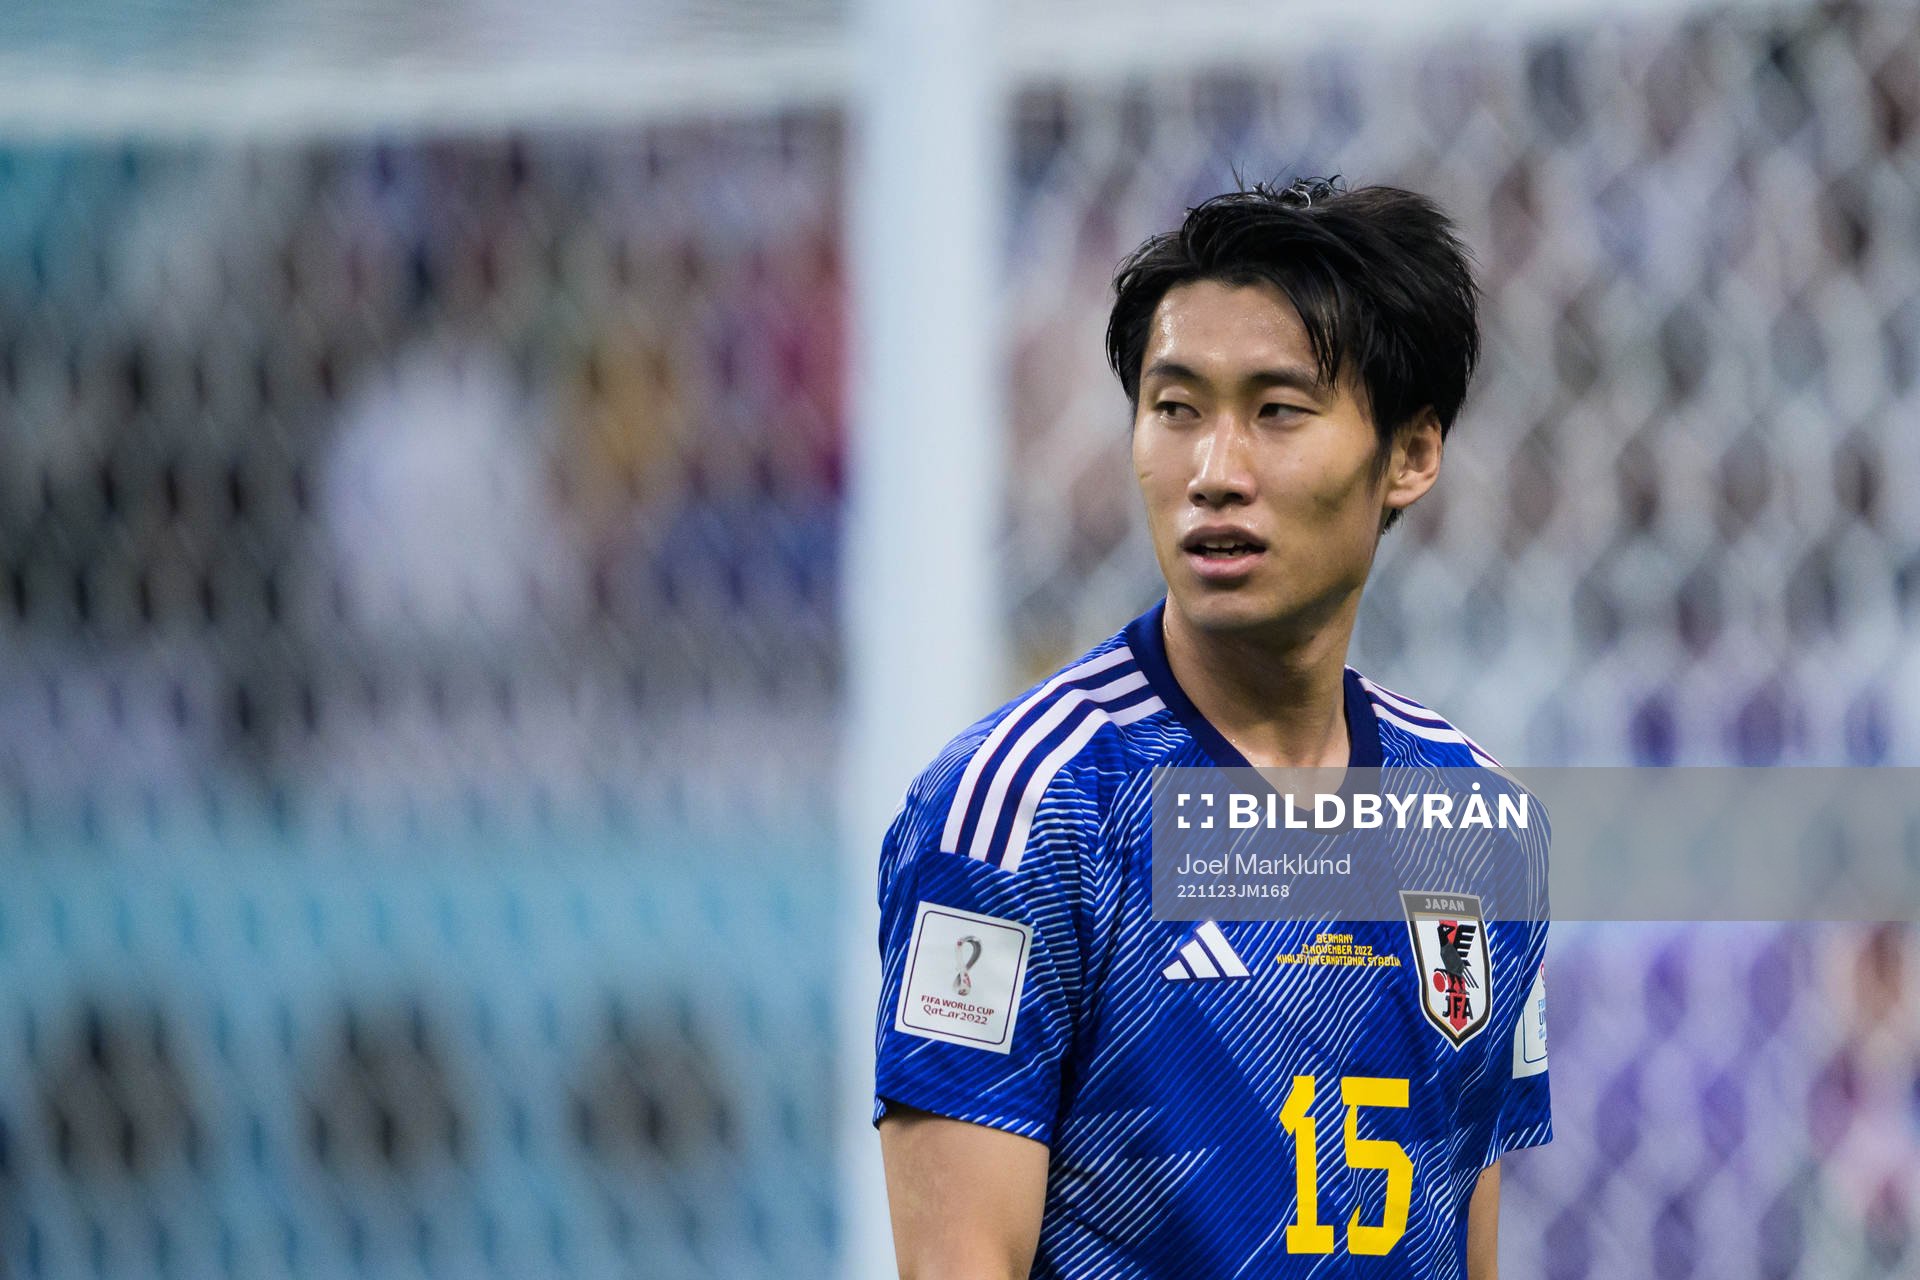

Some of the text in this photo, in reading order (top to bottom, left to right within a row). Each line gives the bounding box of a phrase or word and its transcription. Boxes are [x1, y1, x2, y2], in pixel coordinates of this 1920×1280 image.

[1425, 898, 1465, 912] JAPAN
[1316, 934, 1353, 944] GERMANY
[1310, 944, 1353, 955] NOVEMBER
[1354, 945, 1373, 956] 2022
[1307, 955, 1366, 967] INTERNATIONAL
[921, 995, 994, 1016] FIFA WORLD CUP
[1442, 995, 1473, 1020] JFA
[1279, 1075, 1414, 1256] 15
